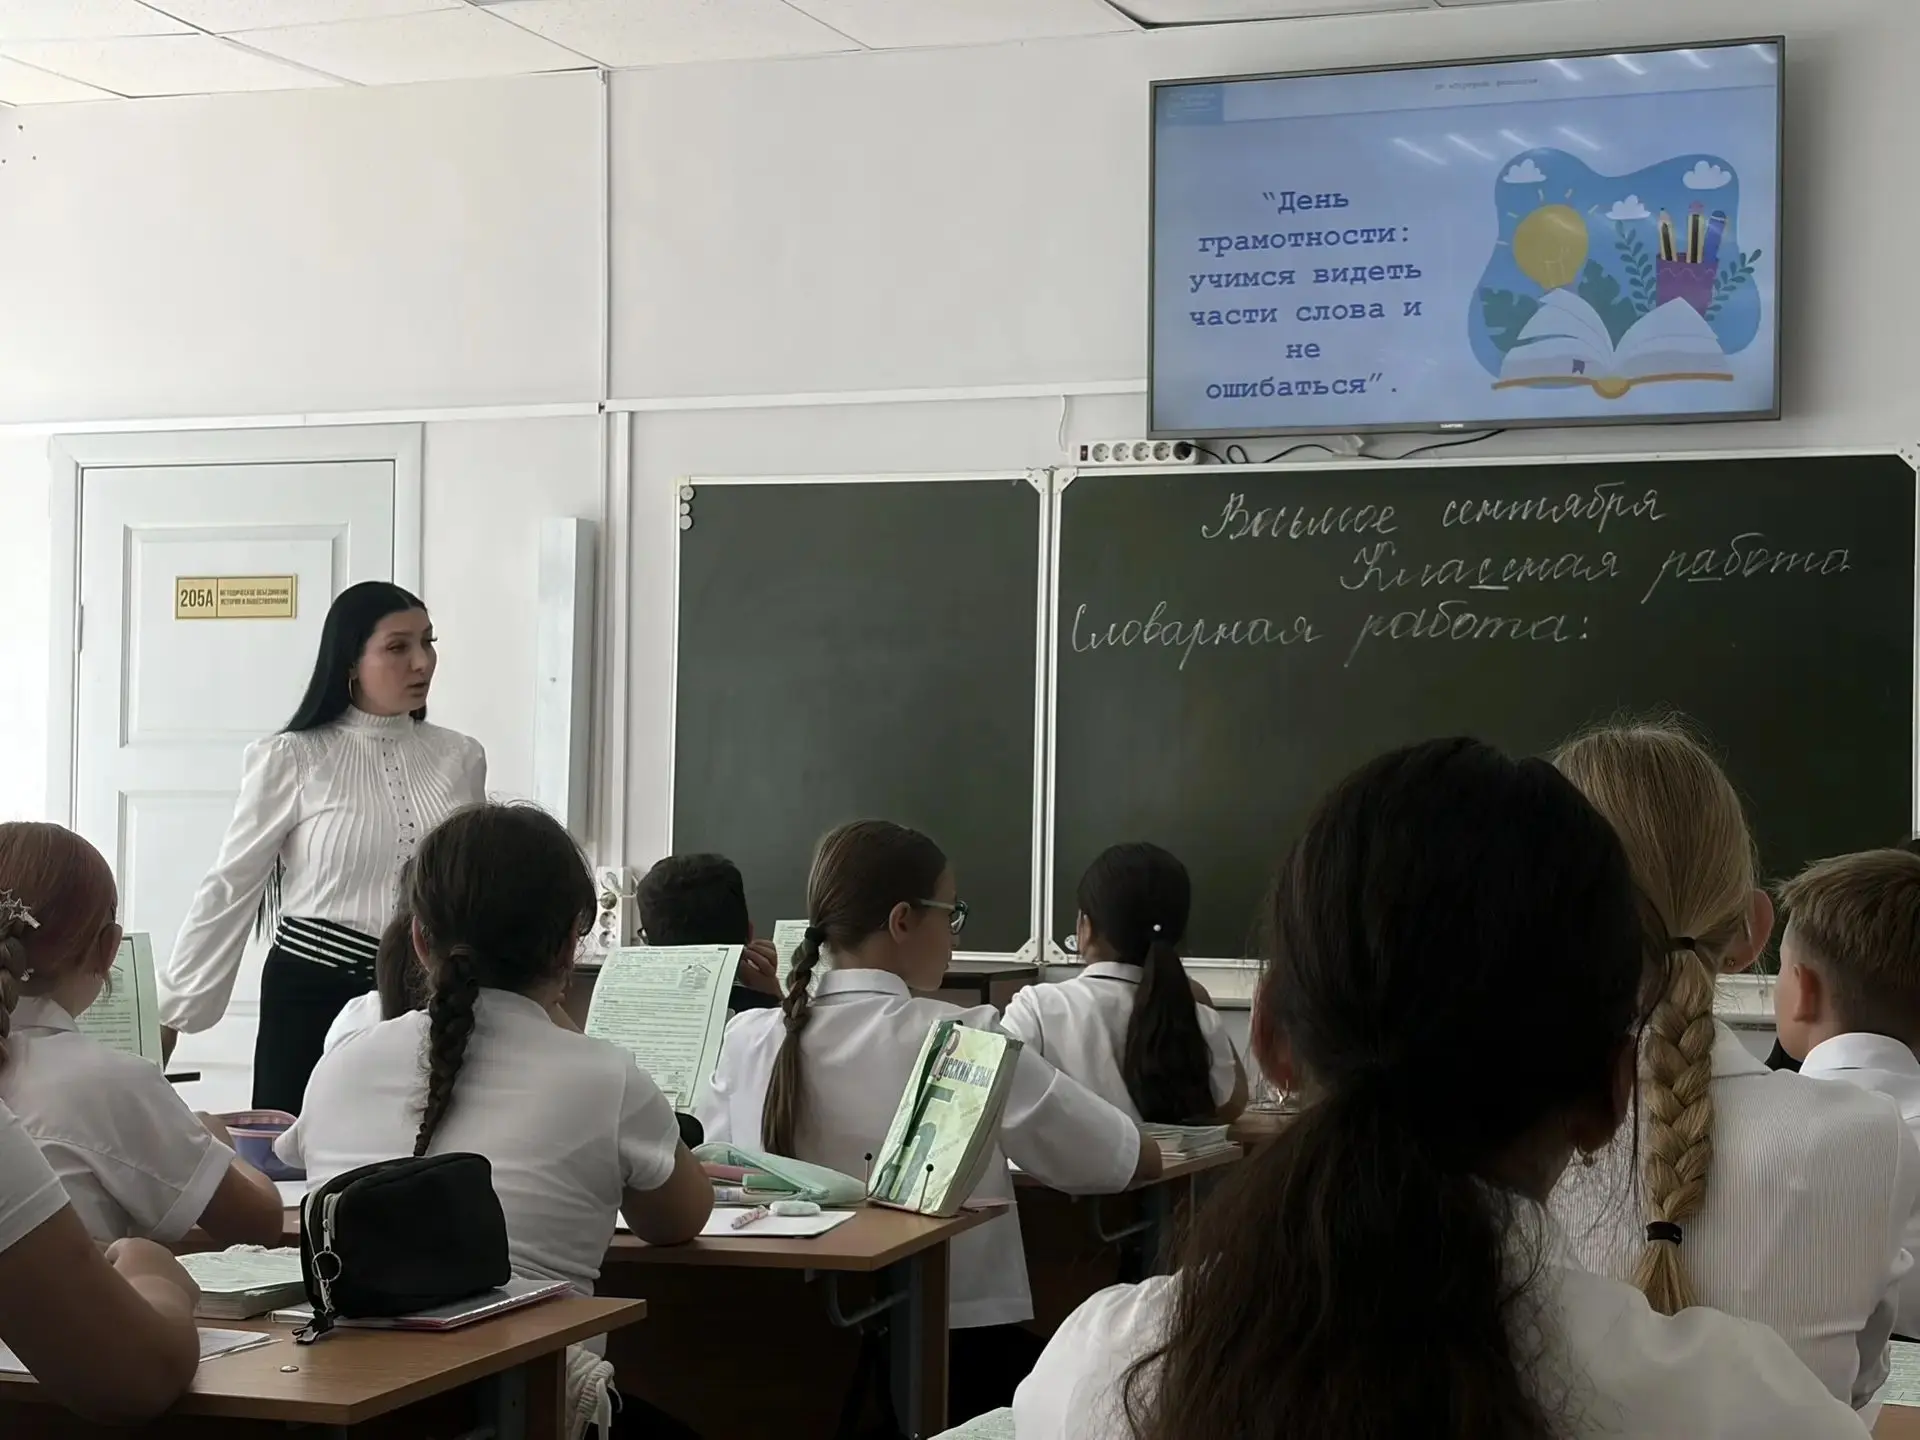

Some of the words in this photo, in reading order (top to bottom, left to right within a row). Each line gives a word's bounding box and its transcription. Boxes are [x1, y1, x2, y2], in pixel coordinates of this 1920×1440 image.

[1197, 226, 1410, 258] грамотности:
[1189, 270, 1296, 293] учимся
[1312, 263, 1422, 286] видеть
[1189, 307, 1278, 326] части
[1295, 302, 1386, 322] слова
[1402, 300, 1423, 317] и
[1285, 342, 1321, 359] не
[1201, 492, 1398, 540] Восьмое
[1442, 481, 1667, 533] сентября
[1340, 540, 1620, 592] Классная
[1640, 532, 1853, 604] работа
[1071, 600, 1324, 671] Словарная
[1342, 600, 1589, 669] работа:
